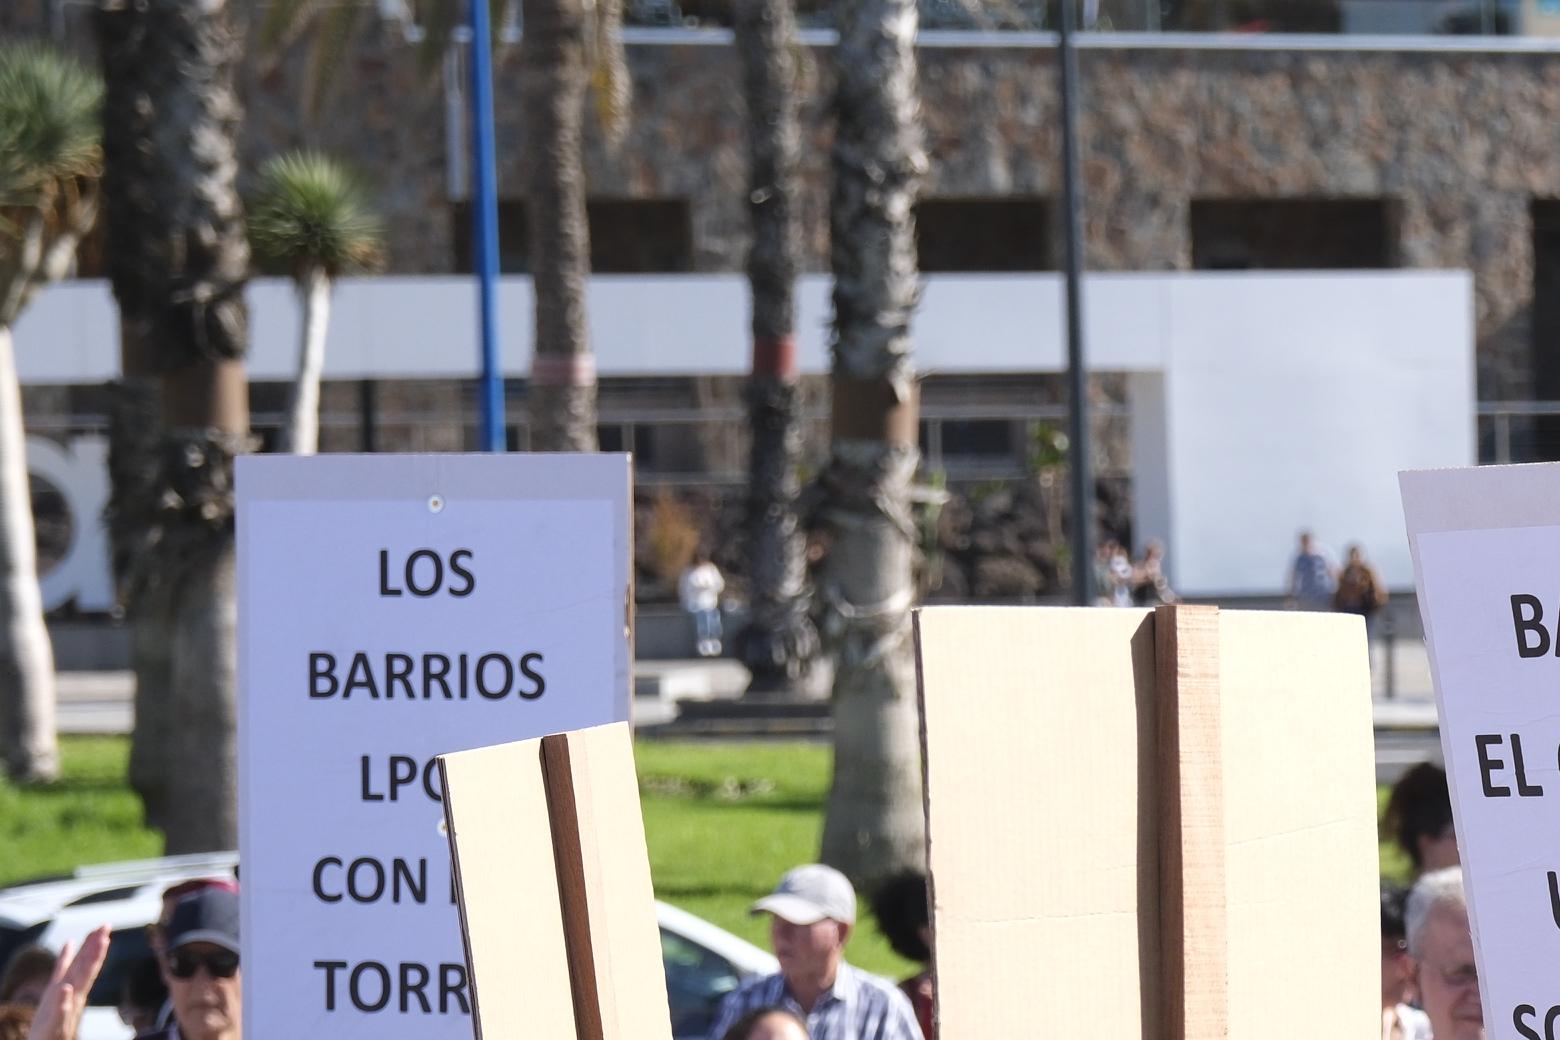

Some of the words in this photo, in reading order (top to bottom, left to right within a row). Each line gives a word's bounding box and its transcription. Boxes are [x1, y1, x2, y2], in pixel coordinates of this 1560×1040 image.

[379, 549, 475, 597] LOS
[308, 652, 546, 701] BARRIOS
[1475, 733, 1544, 797] EL
[312, 856, 427, 905] CON
[313, 961, 471, 1015] TORR
